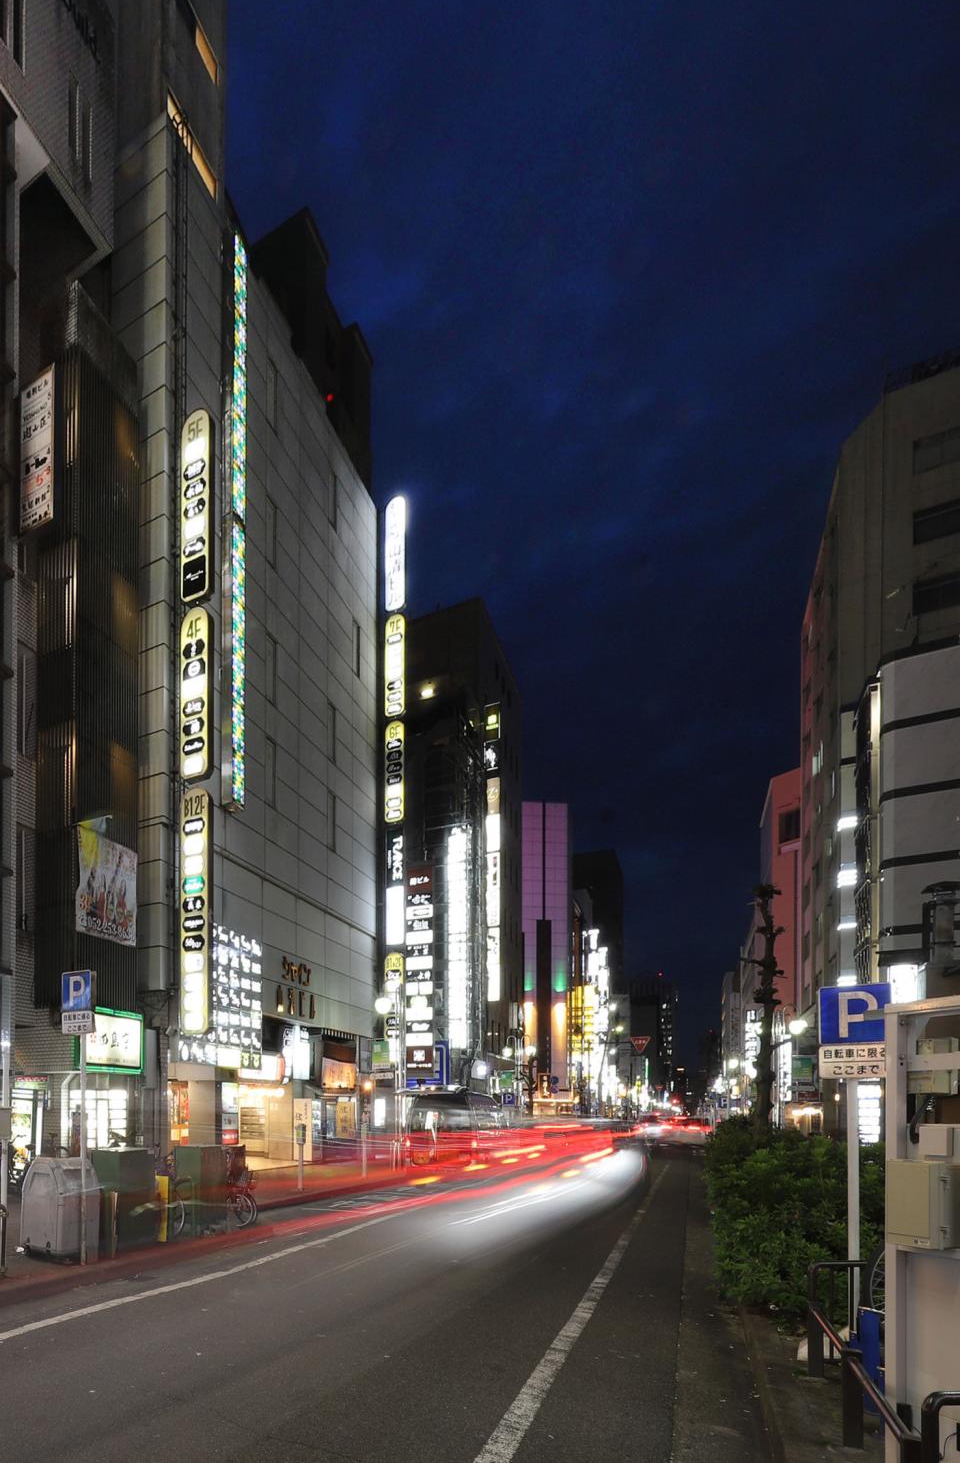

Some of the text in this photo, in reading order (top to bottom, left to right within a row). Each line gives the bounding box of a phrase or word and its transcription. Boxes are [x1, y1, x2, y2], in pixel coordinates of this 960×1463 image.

[187, 418, 204, 441] 5F
[186, 616, 202, 639] 4F
[69, 975, 86, 1007] P
[838, 991, 878, 1039] P
[823, 1048, 886, 1060] 自転車に限る
[833, 1065, 880, 1075] ここまで
